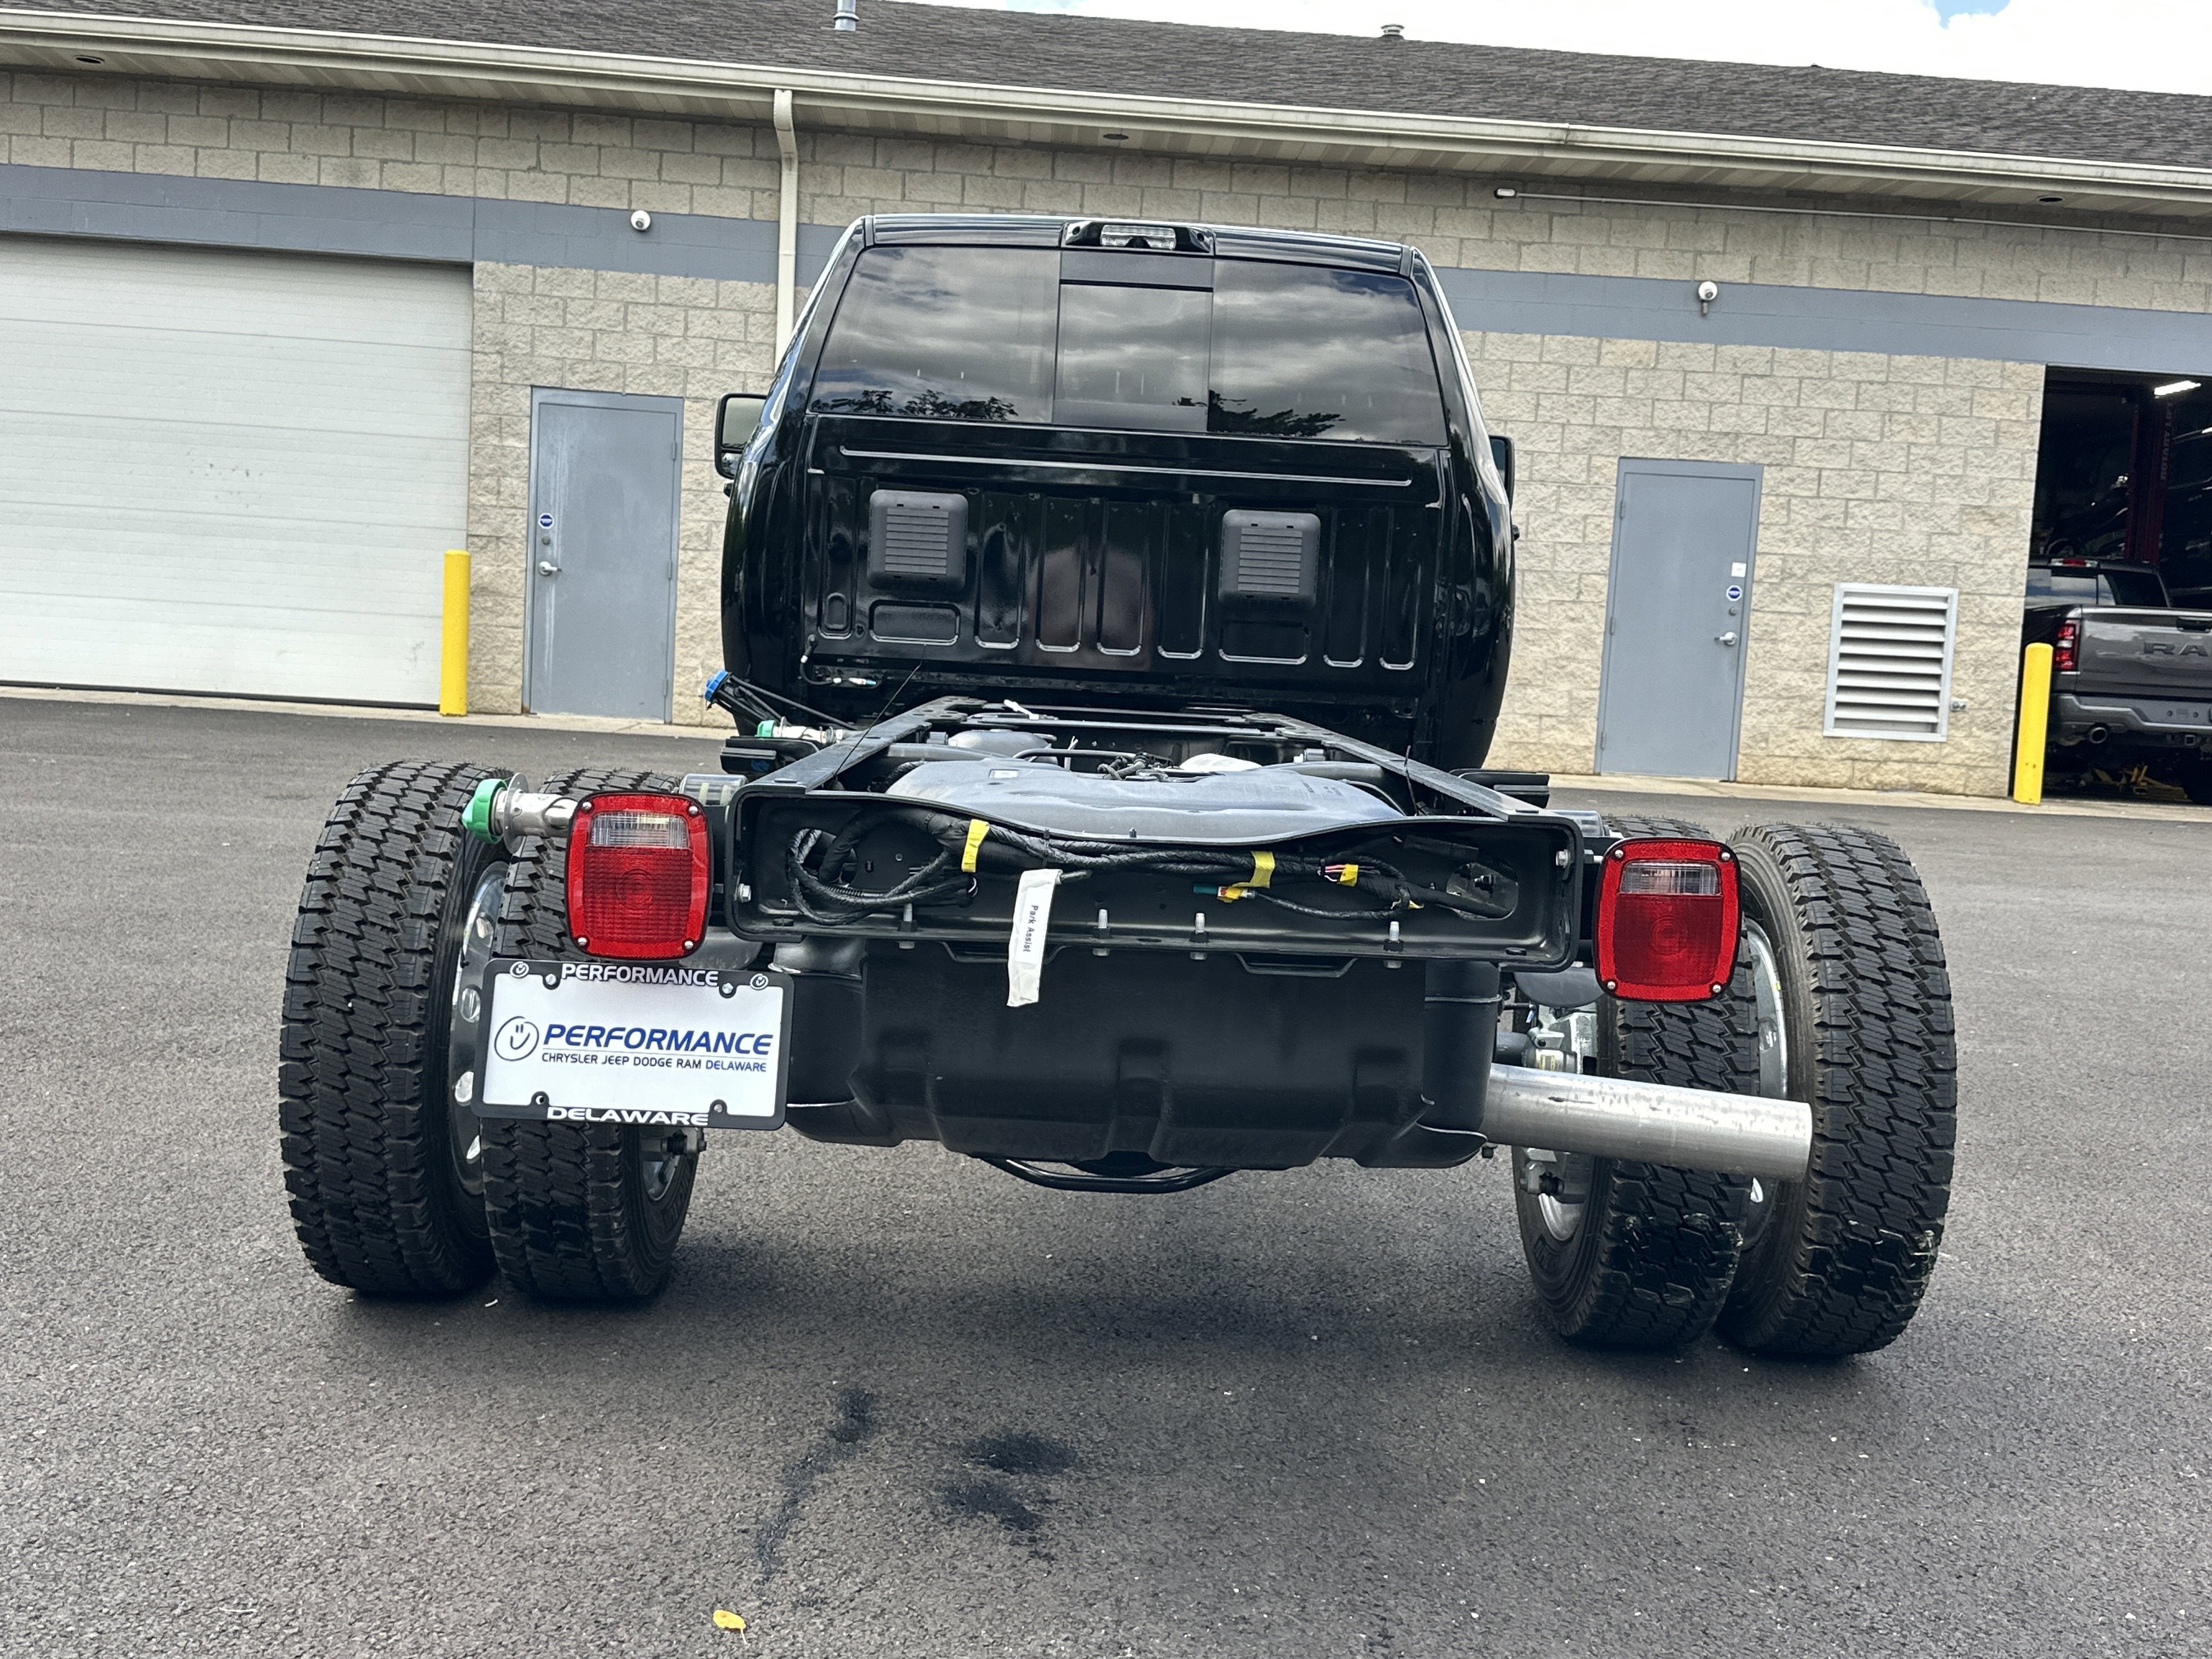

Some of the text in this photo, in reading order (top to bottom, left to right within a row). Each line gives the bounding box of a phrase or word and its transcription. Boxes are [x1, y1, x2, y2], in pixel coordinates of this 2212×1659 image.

[2143, 642, 2212, 657] RA
[1023, 905, 1039, 952] Park Assist
[561, 963, 719, 987] PERFORMANCE
[543, 1024, 774, 1056] PERFORMANCE
[542, 1052, 767, 1073] CHRYSLER JEEP DODGE RAM DELAWARE
[548, 1106, 709, 1126] DELAWARE
